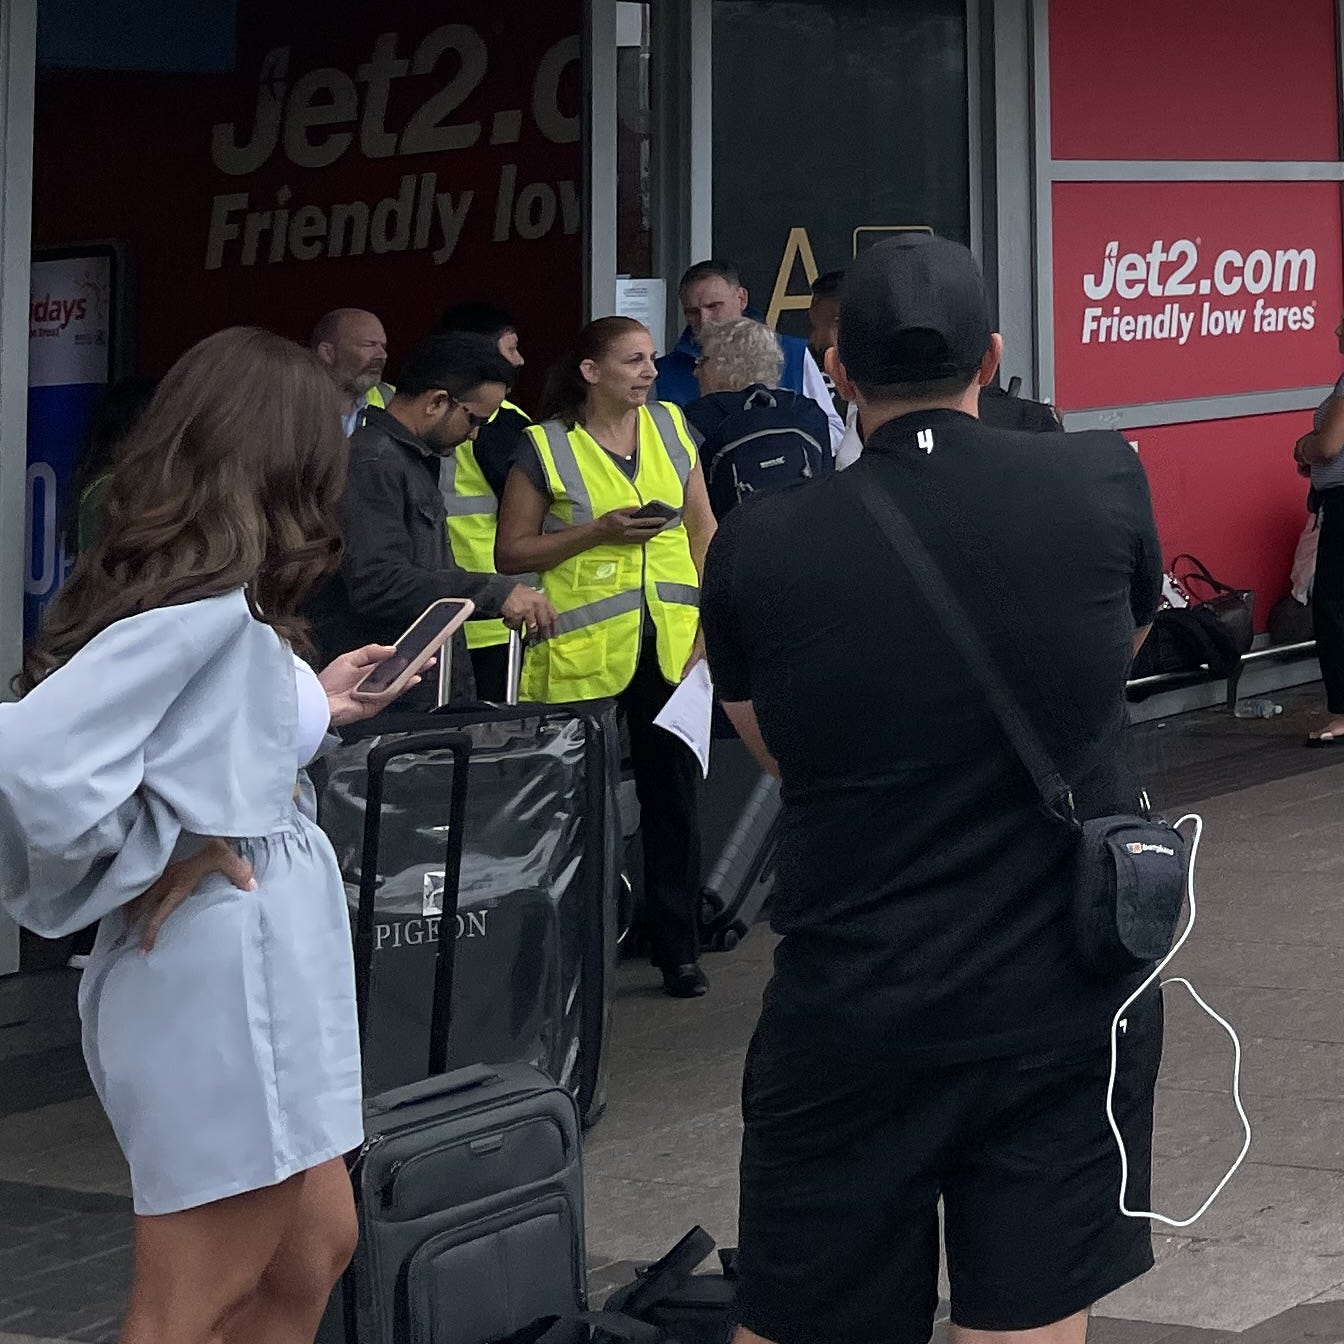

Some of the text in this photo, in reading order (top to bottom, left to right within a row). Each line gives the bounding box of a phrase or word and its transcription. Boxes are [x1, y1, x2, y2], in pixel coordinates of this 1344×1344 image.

[211, 23, 581, 176] Jet2.c
[204, 171, 474, 271] Friendly
[1083, 239, 1316, 301] Jet2.com
[31, 293, 86, 330] days
[1082, 298, 1315, 346] Friendly low fares
